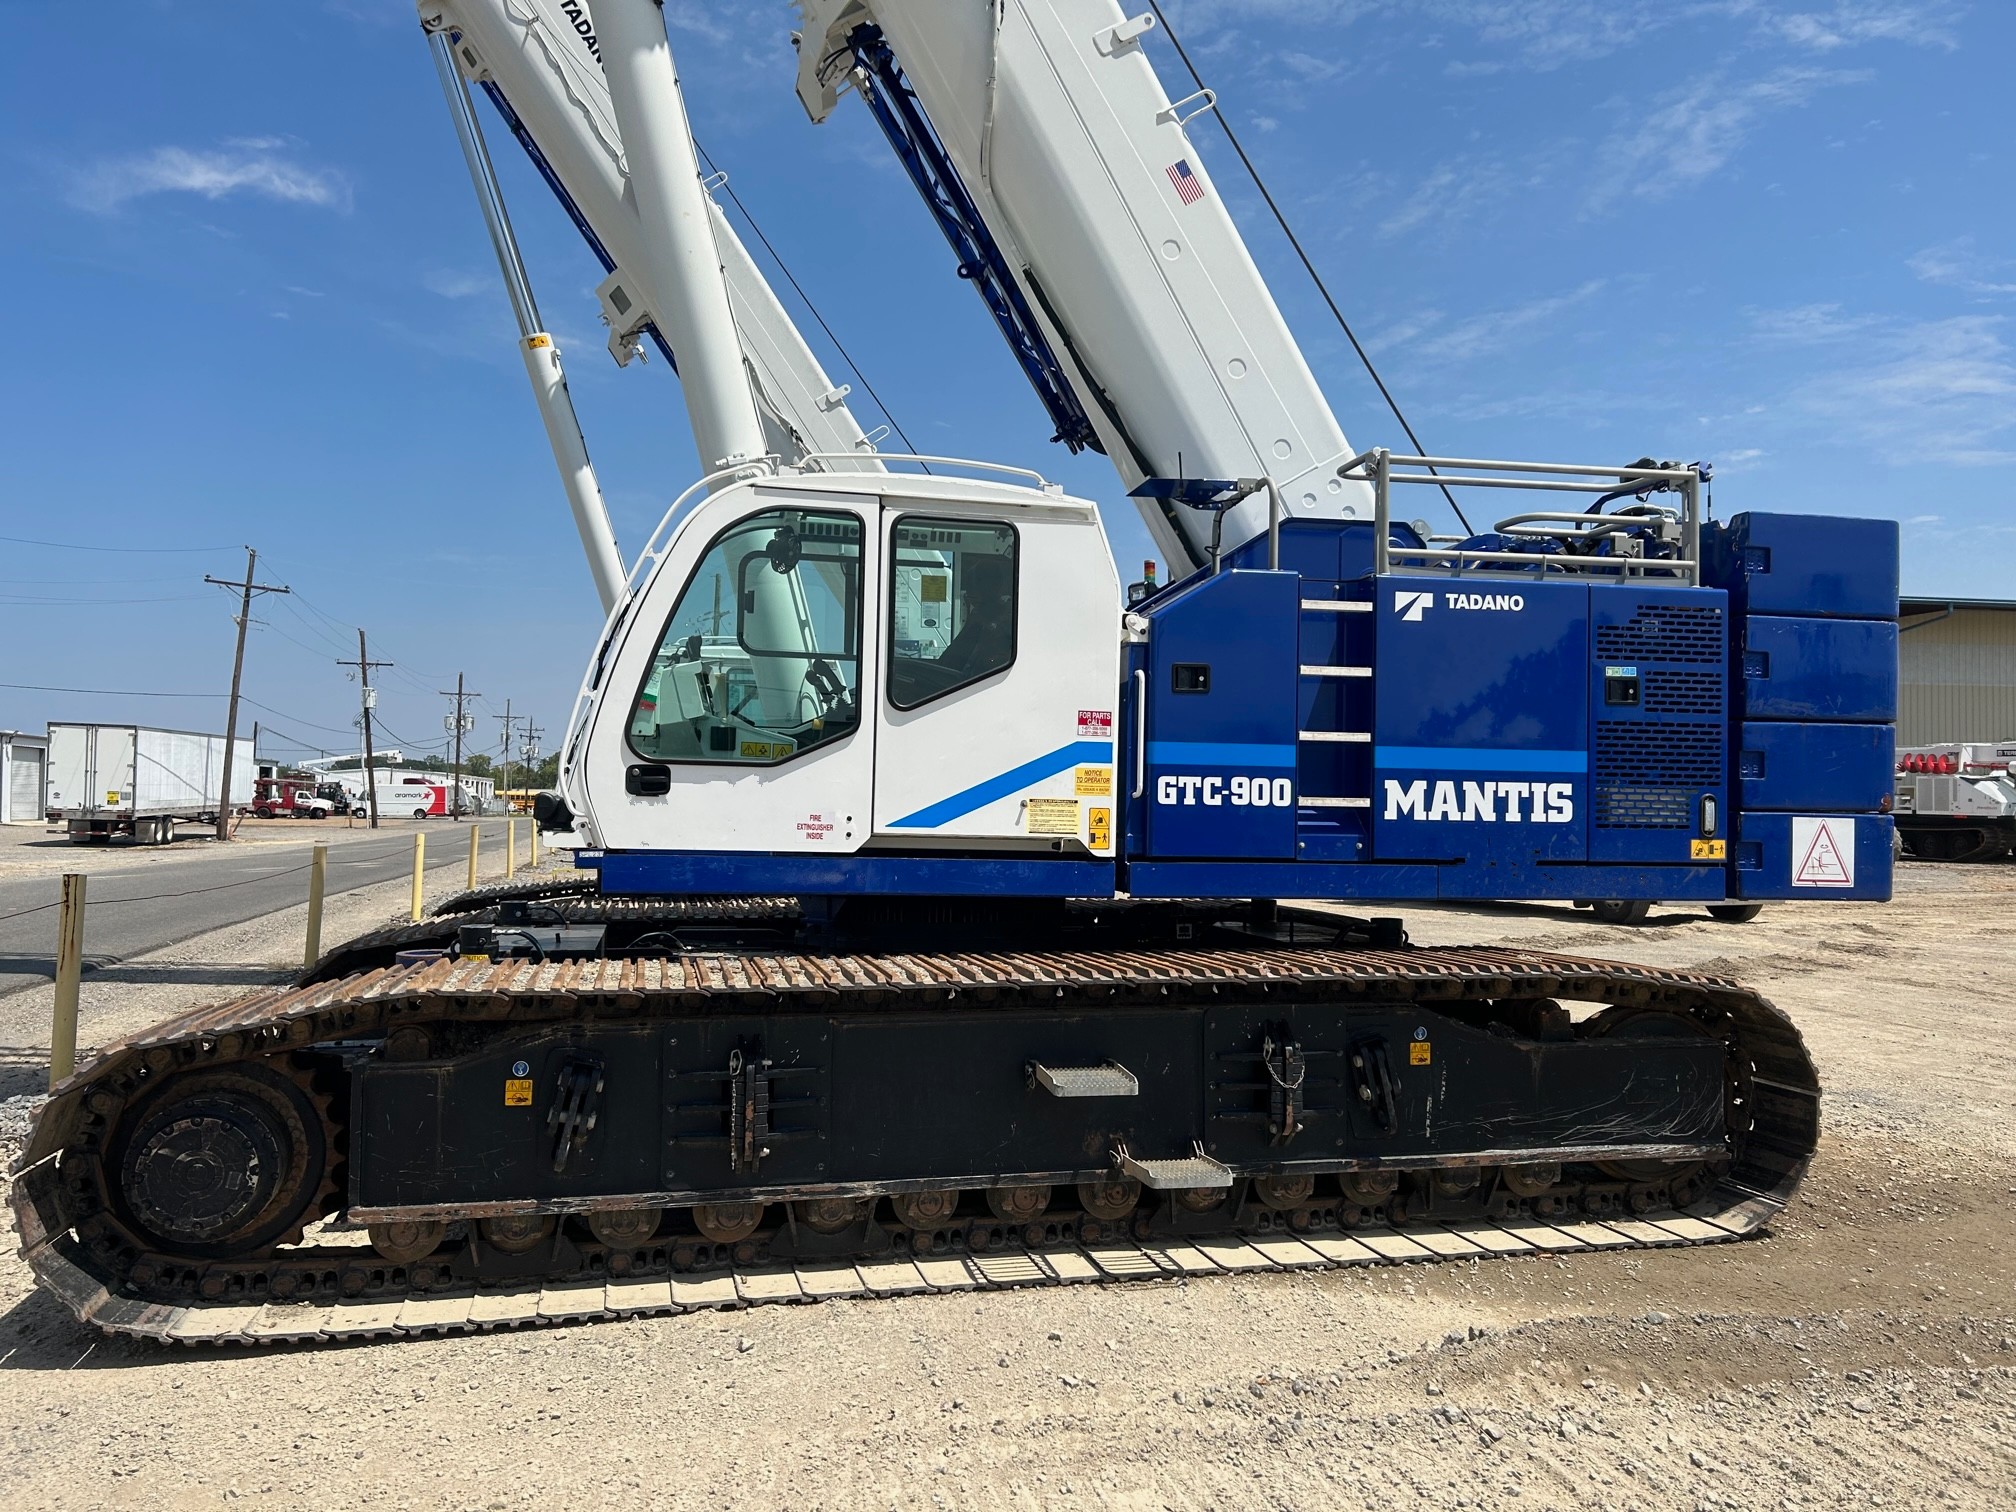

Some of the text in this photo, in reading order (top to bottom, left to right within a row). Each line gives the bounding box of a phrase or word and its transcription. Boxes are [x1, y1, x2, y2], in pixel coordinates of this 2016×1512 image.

[560, 0, 605, 74] TADAN
[1445, 593, 1524, 611] TADANO
[1080, 711, 1111, 720] FOR PARTS
[1084, 769, 1102, 777] NOTICE
[1157, 775, 1292, 808] GTC-900
[1383, 779, 1574, 823] MANTIS
[797, 823, 833, 831] EXTINGUISHER
